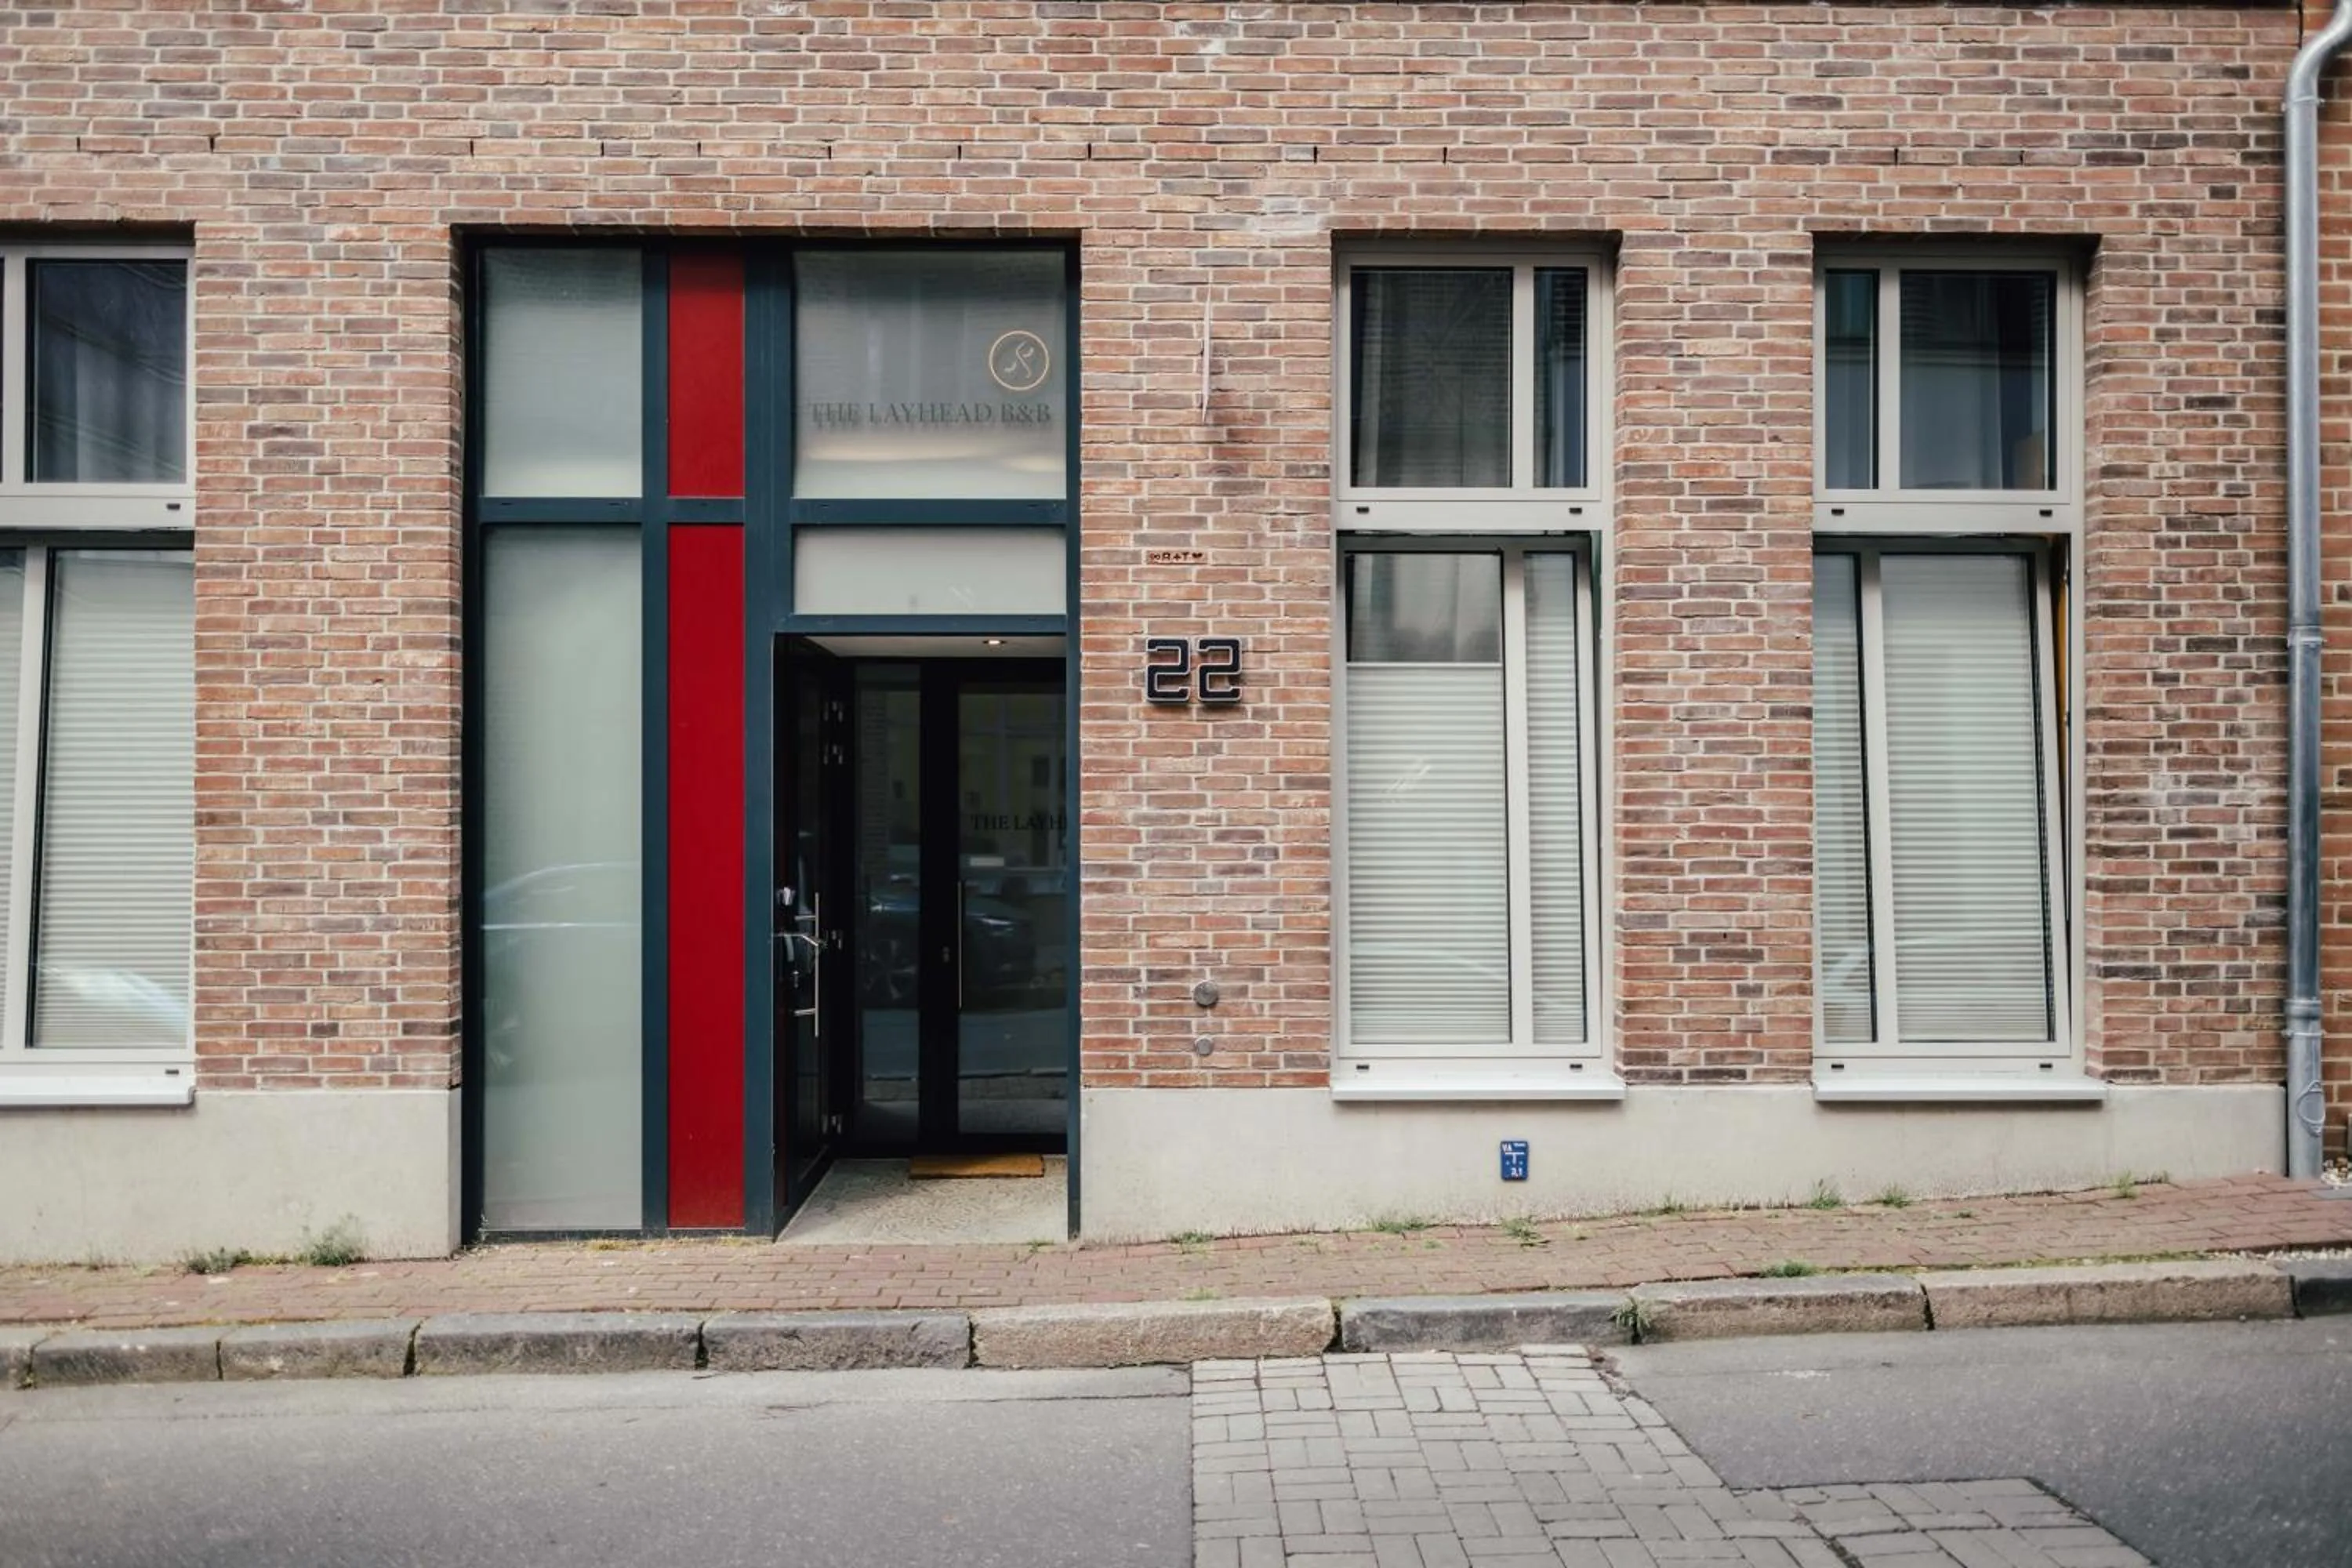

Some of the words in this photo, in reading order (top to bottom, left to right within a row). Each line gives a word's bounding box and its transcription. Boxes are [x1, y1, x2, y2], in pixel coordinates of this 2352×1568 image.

[811, 402, 860, 423] THE
[869, 402, 993, 423] LAYHEAD
[1000, 402, 1051, 423] B&B
[1146, 637, 1242, 702] 22
[970, 814, 1009, 830] THE
[1014, 814, 1067, 830] LAYH
